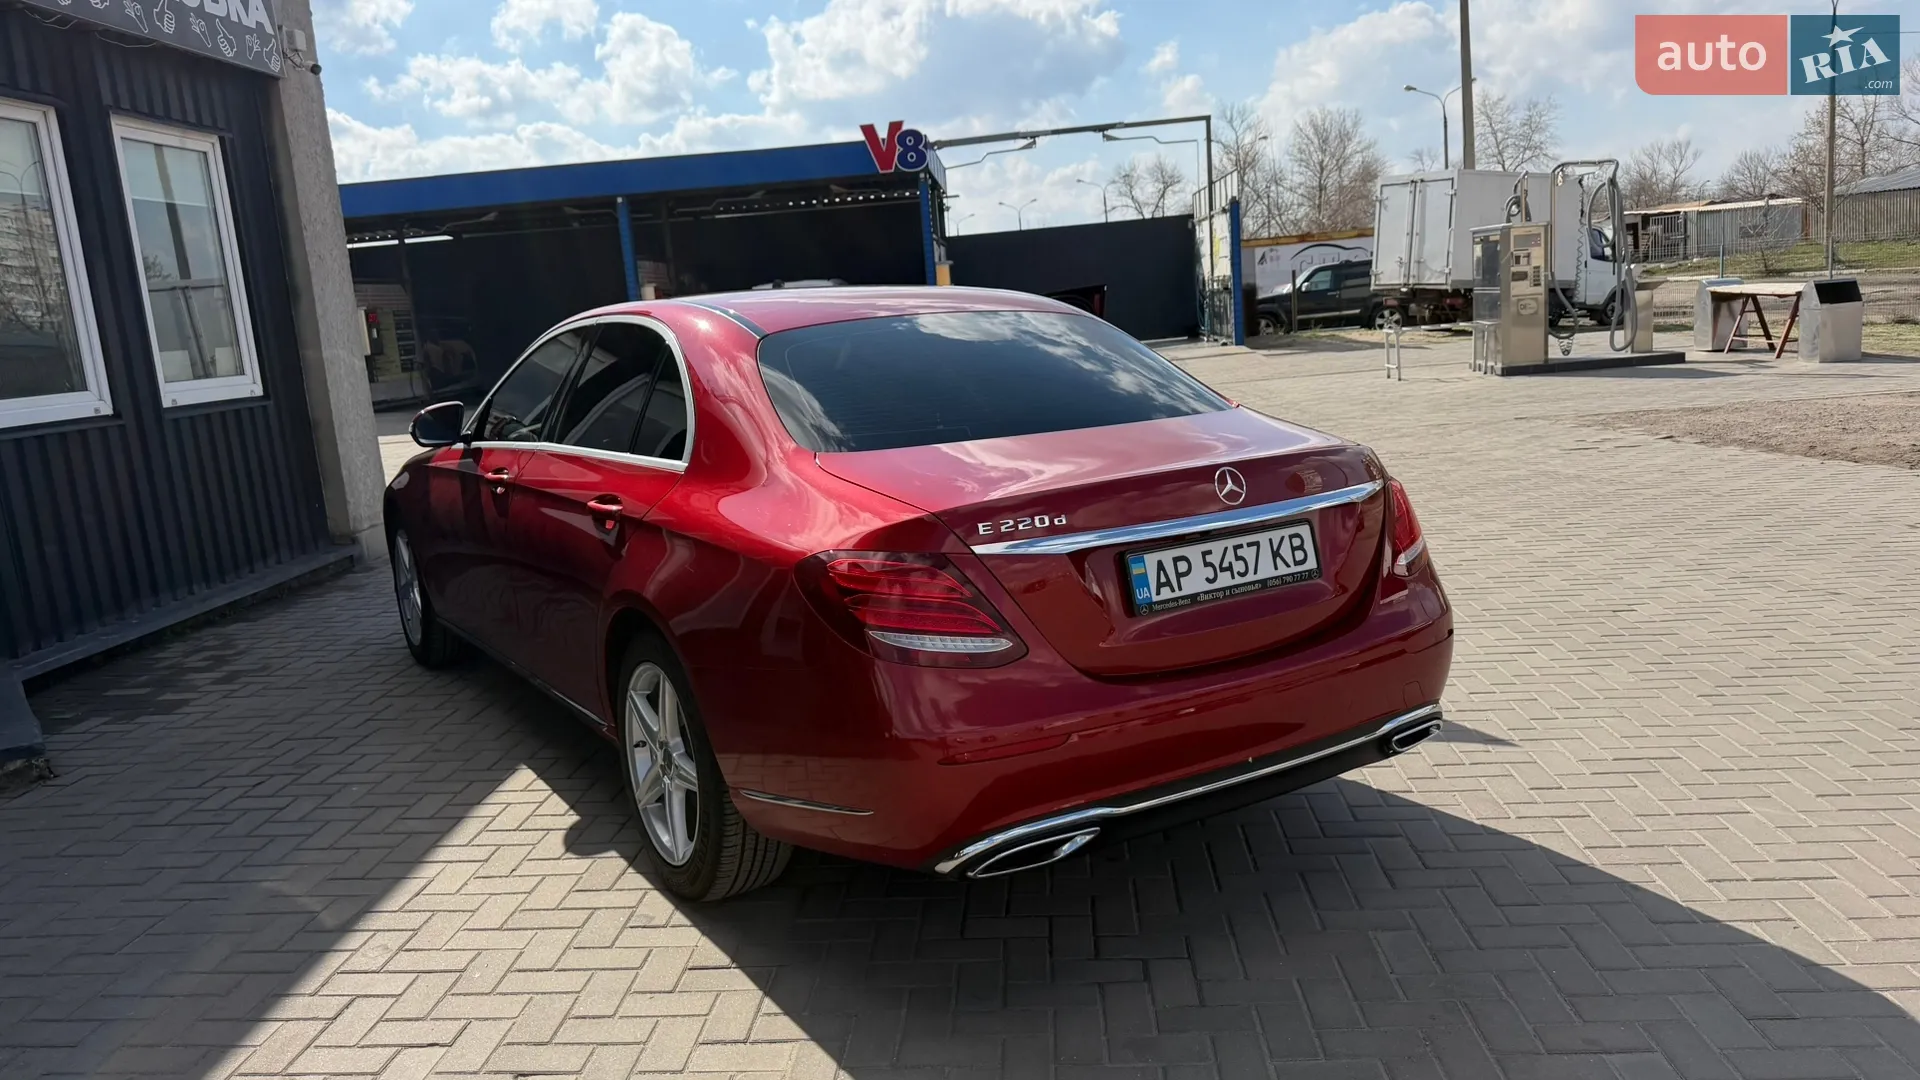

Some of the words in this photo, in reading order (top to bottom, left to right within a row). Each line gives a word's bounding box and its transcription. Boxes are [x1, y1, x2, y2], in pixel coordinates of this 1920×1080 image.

[859, 120, 928, 173] V8
[977, 522, 994, 535] E
[1155, 555, 1193, 596] AP
[1201, 540, 1261, 585] 5457
[1268, 532, 1308, 571] KB
[1136, 586, 1151, 600] UA
[1152, 598, 1191, 611] Mercedes-Benz
